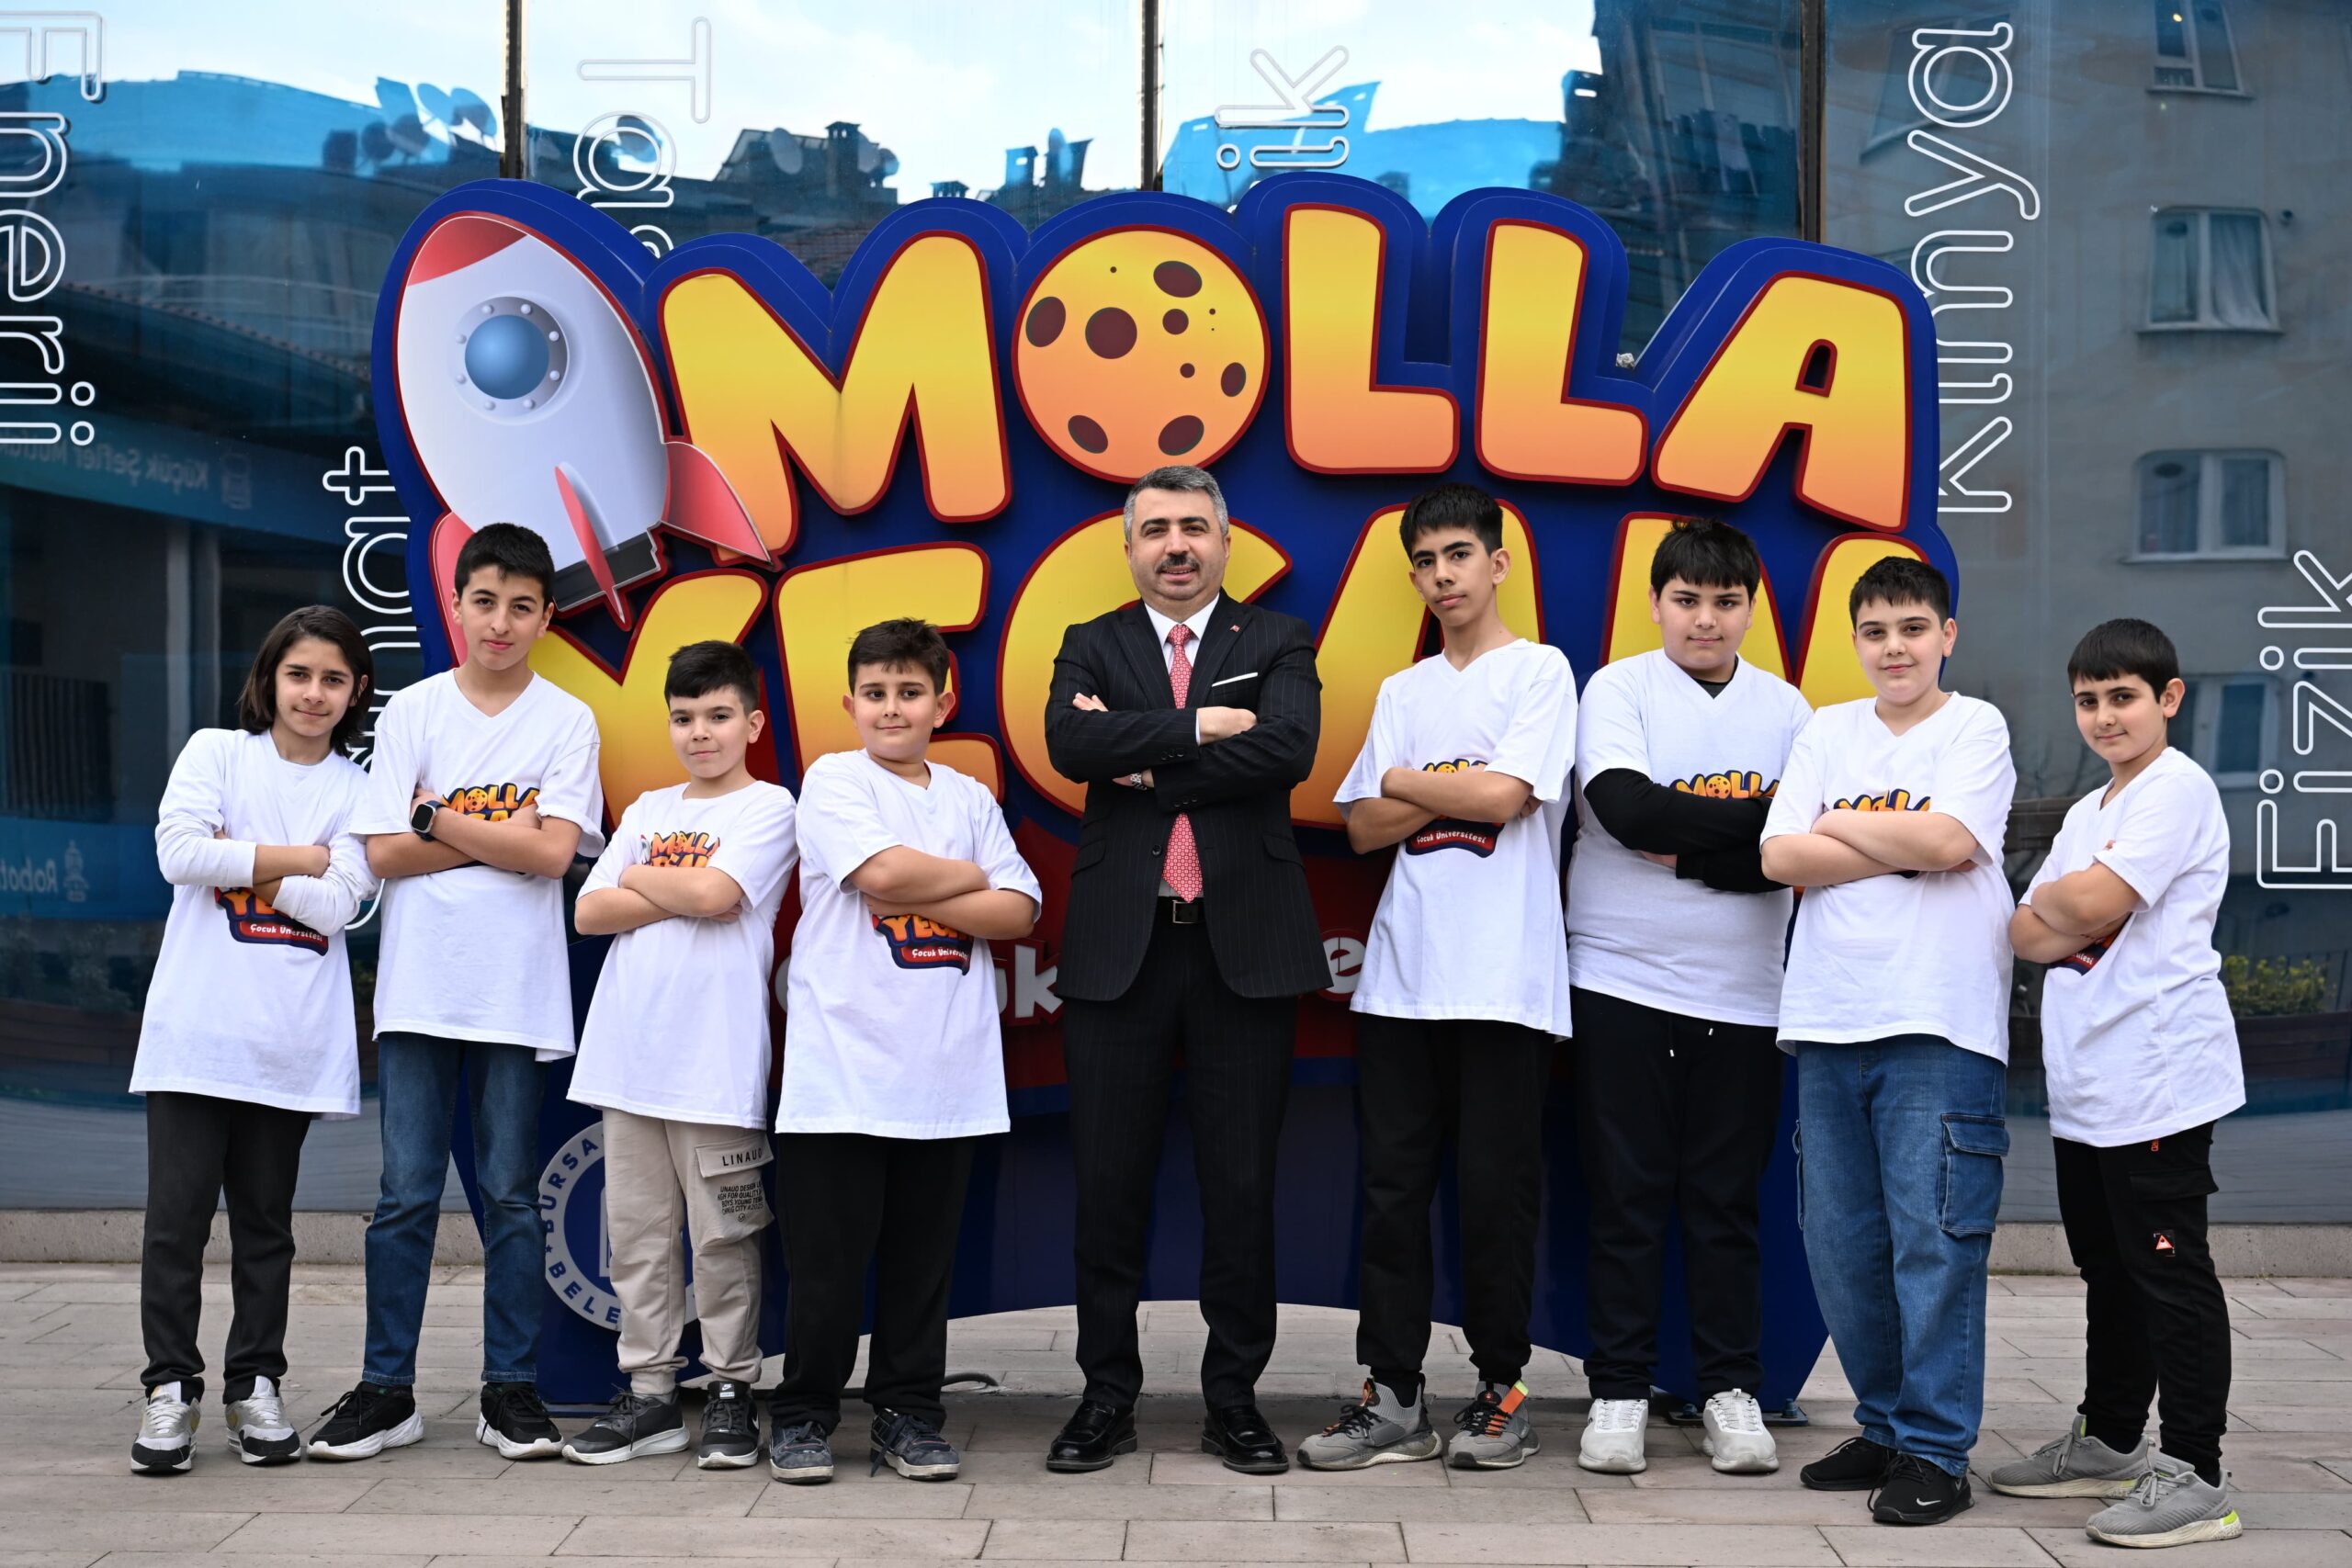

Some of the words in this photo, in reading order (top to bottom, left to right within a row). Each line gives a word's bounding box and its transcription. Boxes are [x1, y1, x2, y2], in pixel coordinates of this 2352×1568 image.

[658, 202, 1912, 565] MOLLA
[250, 923, 277, 934] Çocuk
[911, 947, 936, 959] Çocuk
